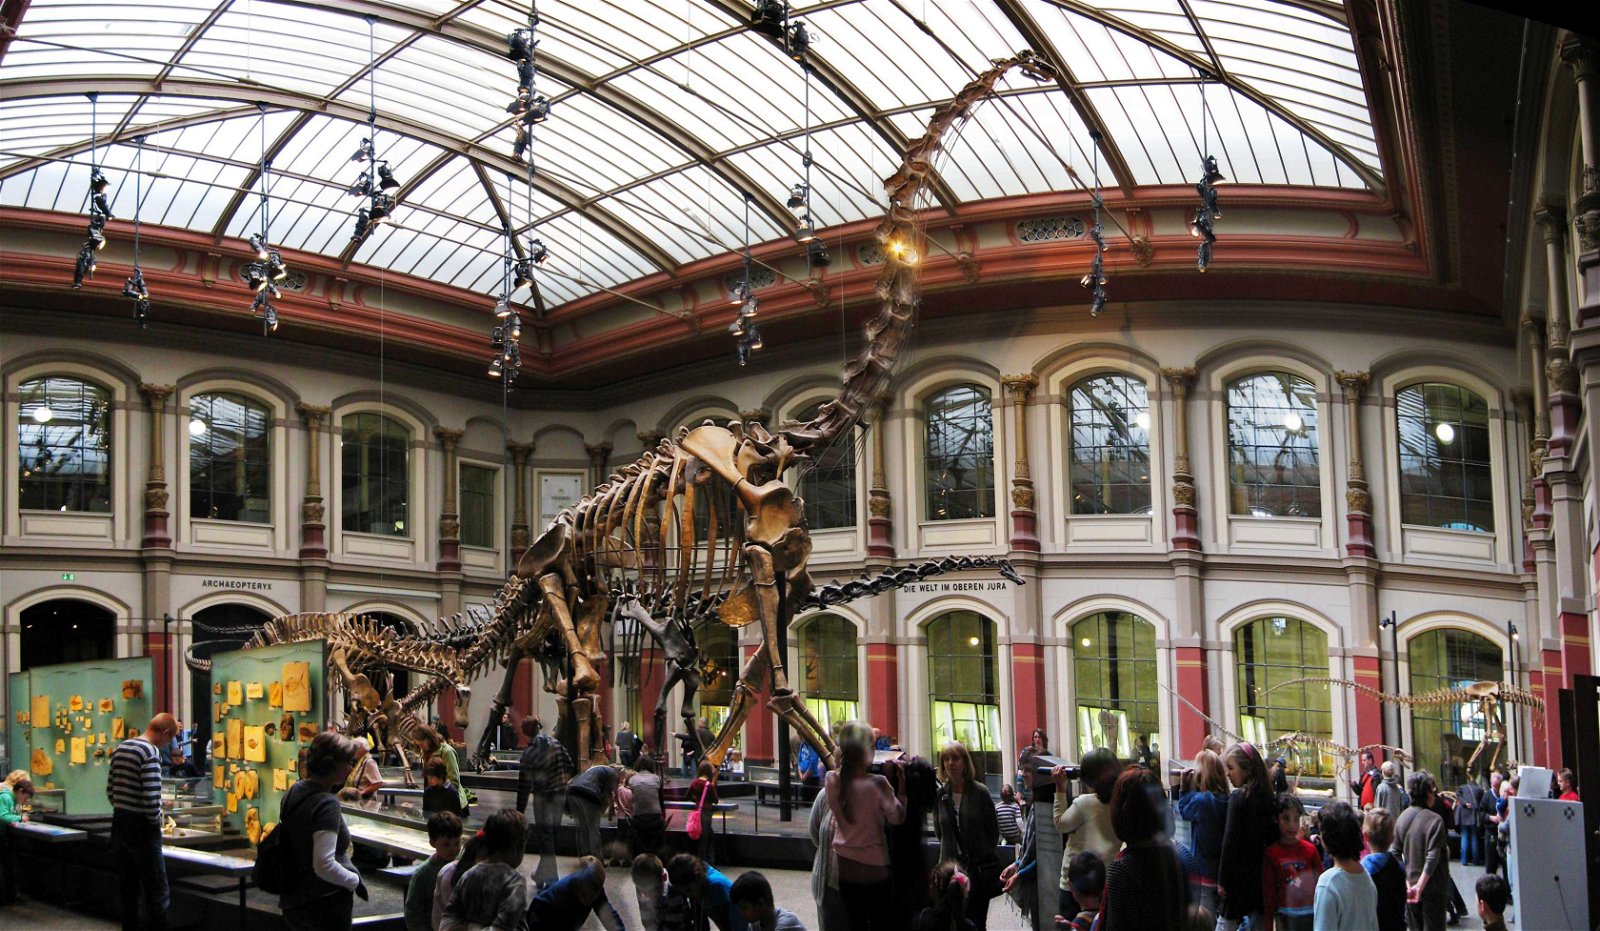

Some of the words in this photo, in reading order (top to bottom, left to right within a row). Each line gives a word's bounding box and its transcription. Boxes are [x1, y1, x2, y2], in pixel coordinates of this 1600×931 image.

[202, 579, 272, 590] ARCHAEOPTERYX
[903, 585, 916, 593] DIE
[920, 583, 938, 592] WELT
[941, 583, 950, 591] IM
[952, 582, 984, 591] OBEREN
[987, 582, 1007, 591] JURA
